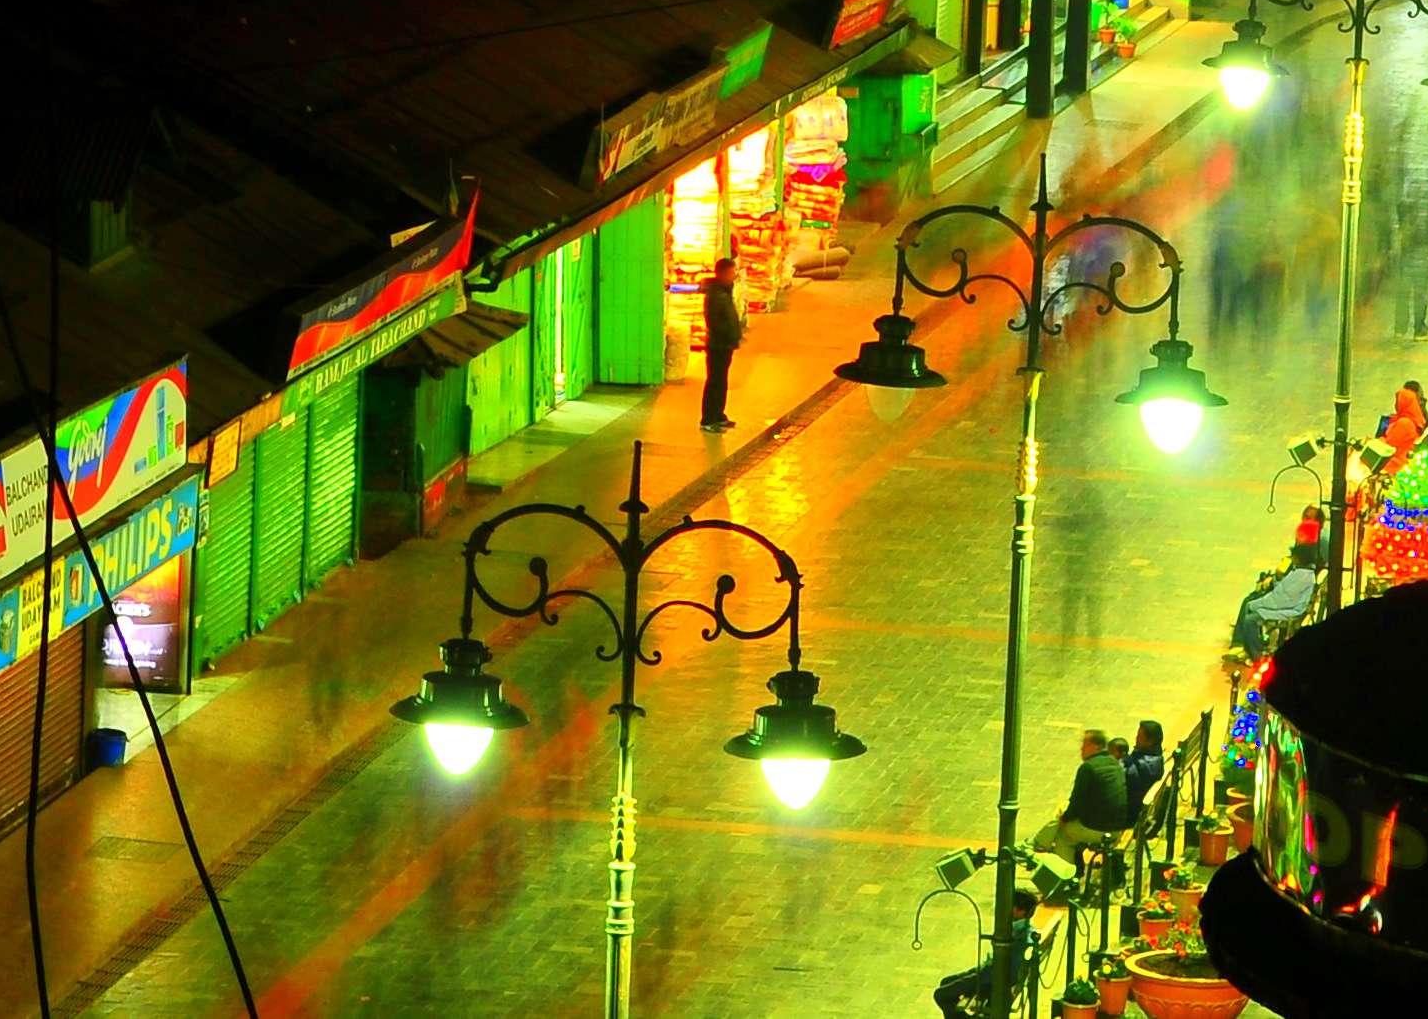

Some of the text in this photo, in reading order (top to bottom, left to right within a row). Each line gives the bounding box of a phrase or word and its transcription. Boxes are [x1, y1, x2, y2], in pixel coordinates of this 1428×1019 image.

[87, 498, 173, 607] PHILIPS
[22, 568, 63, 609] BALCND
[22, 591, 62, 632] UDAYM
